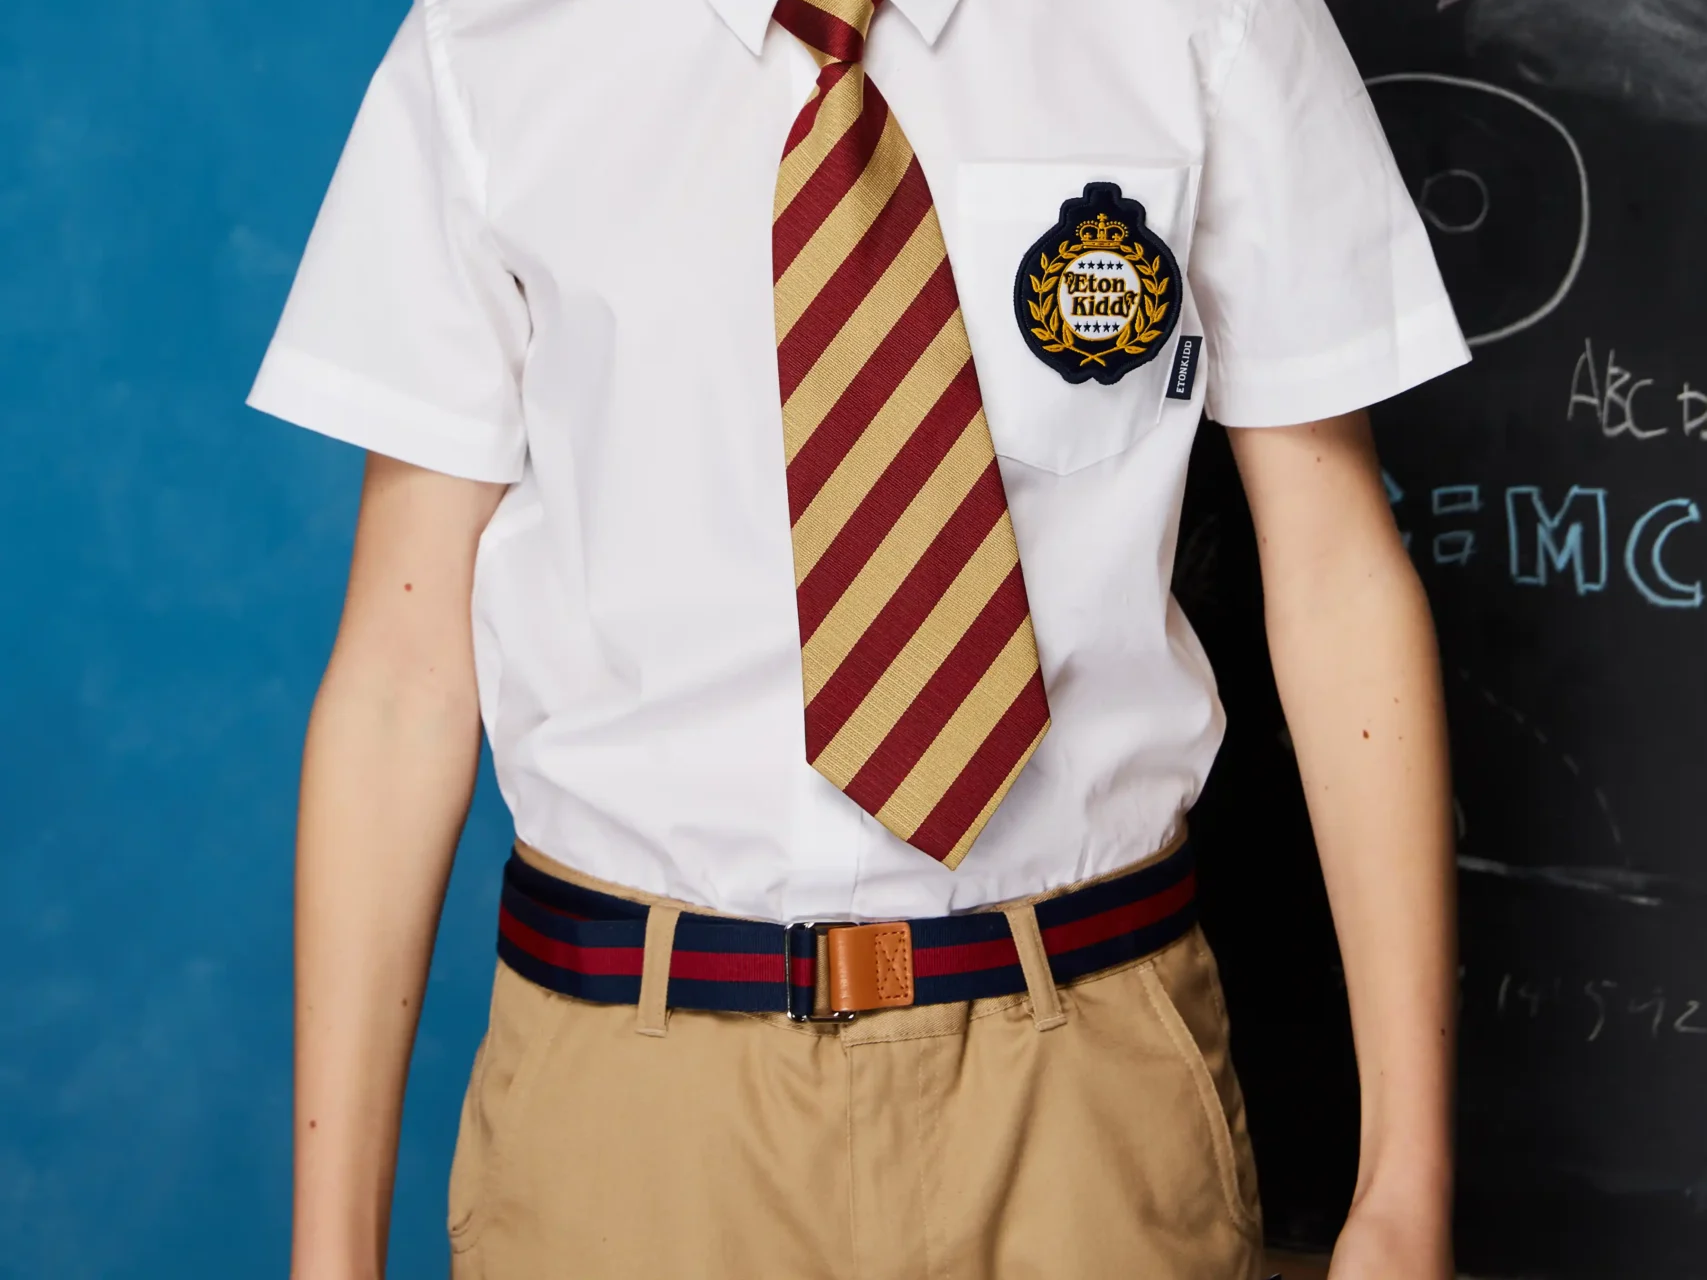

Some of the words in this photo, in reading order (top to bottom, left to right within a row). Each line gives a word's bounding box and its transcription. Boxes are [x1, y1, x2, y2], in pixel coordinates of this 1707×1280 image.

[1063, 271, 1125, 294] Eton
[1071, 290, 1137, 317] Kidd
[1176, 340, 1192, 393] ETONKIDD
